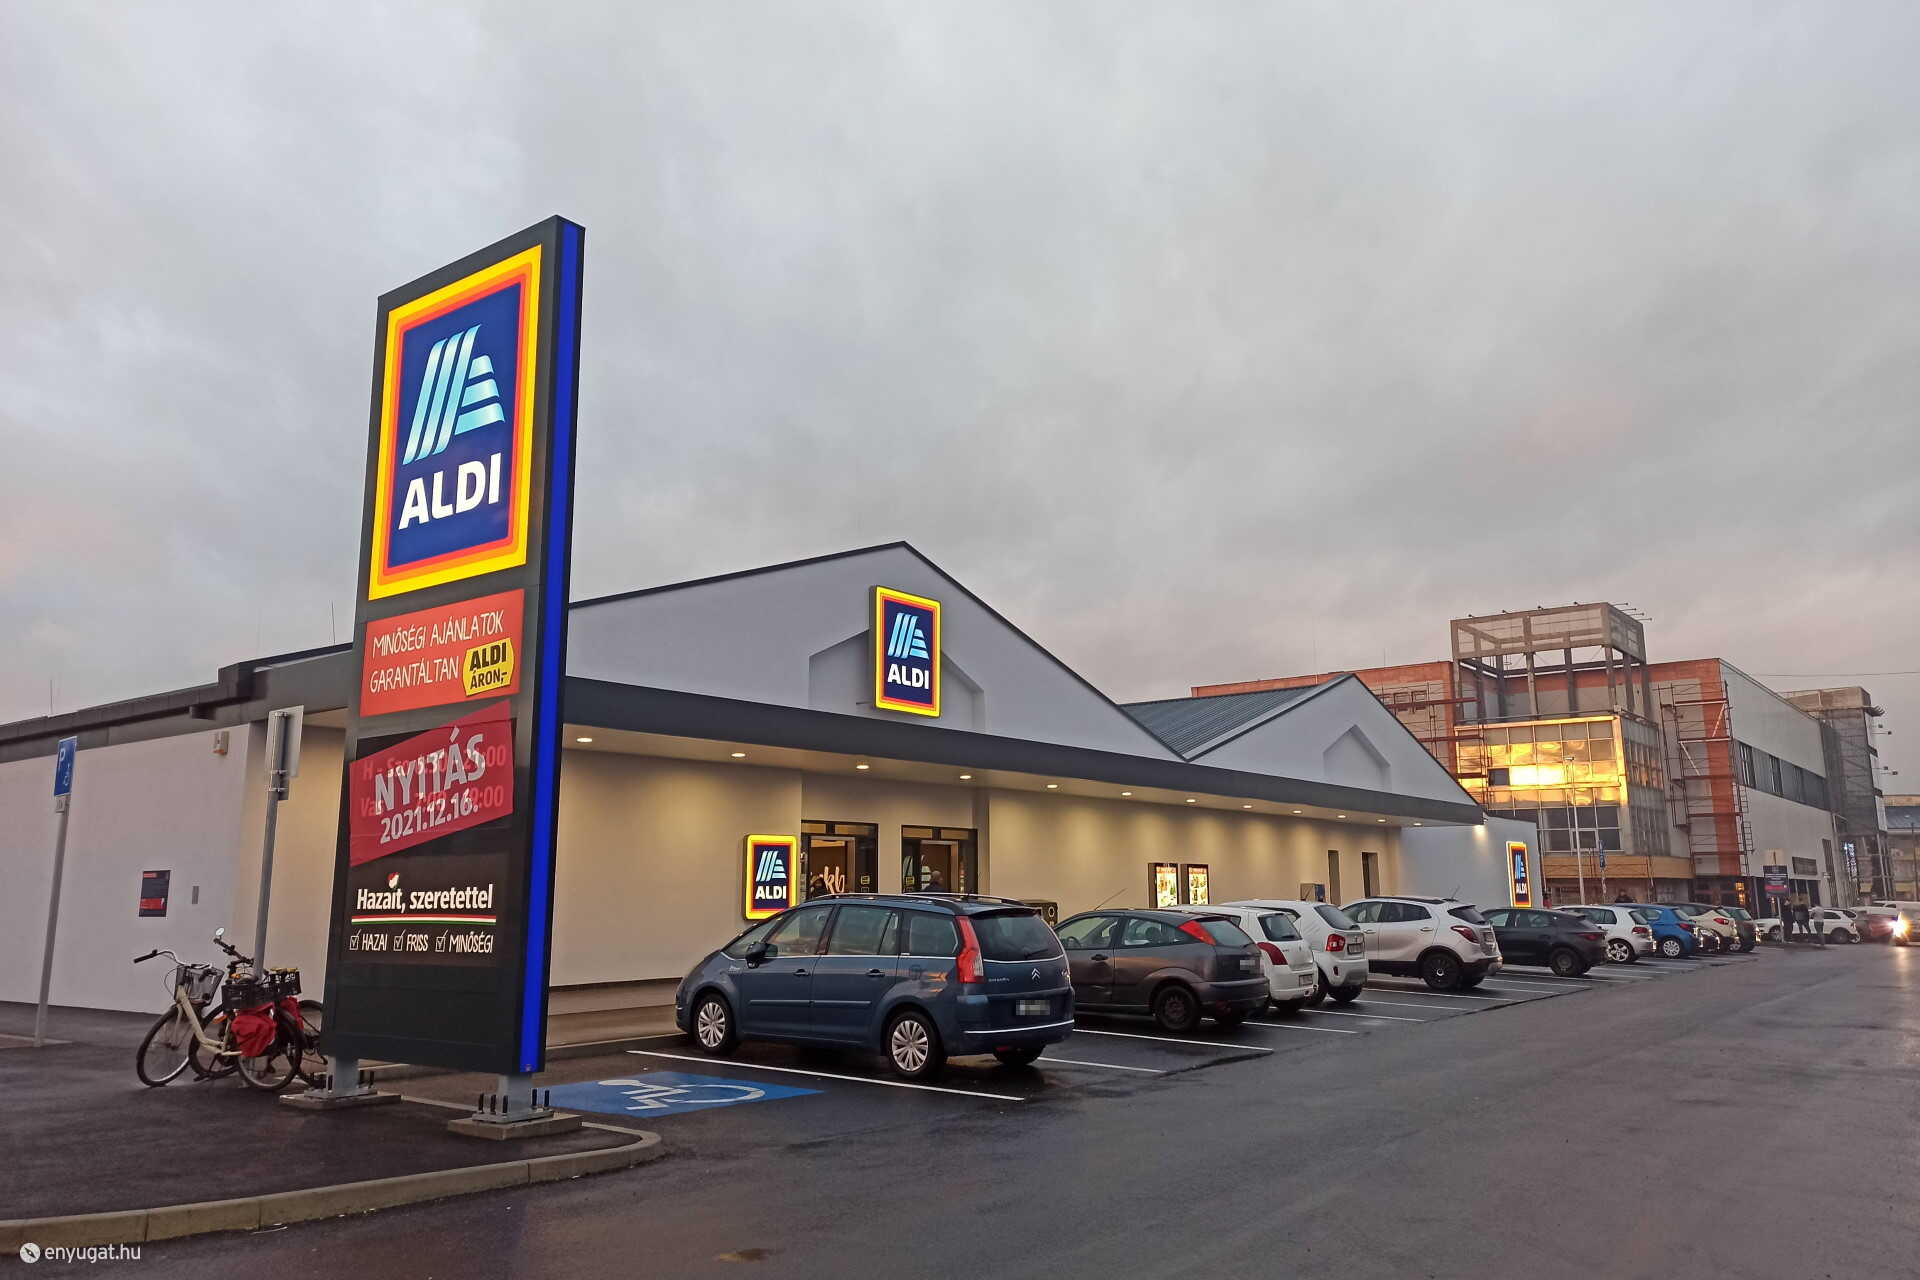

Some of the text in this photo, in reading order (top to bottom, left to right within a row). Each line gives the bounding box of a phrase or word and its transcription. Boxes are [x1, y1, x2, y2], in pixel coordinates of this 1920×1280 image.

[398, 452, 502, 530] ALDI
[372, 610, 504, 658] MINŐSÉGI AJÁNLATOK
[469, 642, 507, 671] ALDI
[370, 656, 459, 693] GARANTÁLTAN
[887, 663, 930, 690] ALDI
[375, 725, 486, 816] NYITÁS
[380, 788, 479, 845] 2021.12.16.
[356, 884, 493, 914] Hazait, szeretettel
[755, 885, 787, 900] ALDI
[361, 933, 387, 951] HAZAI
[406, 933, 428, 952] FRISS
